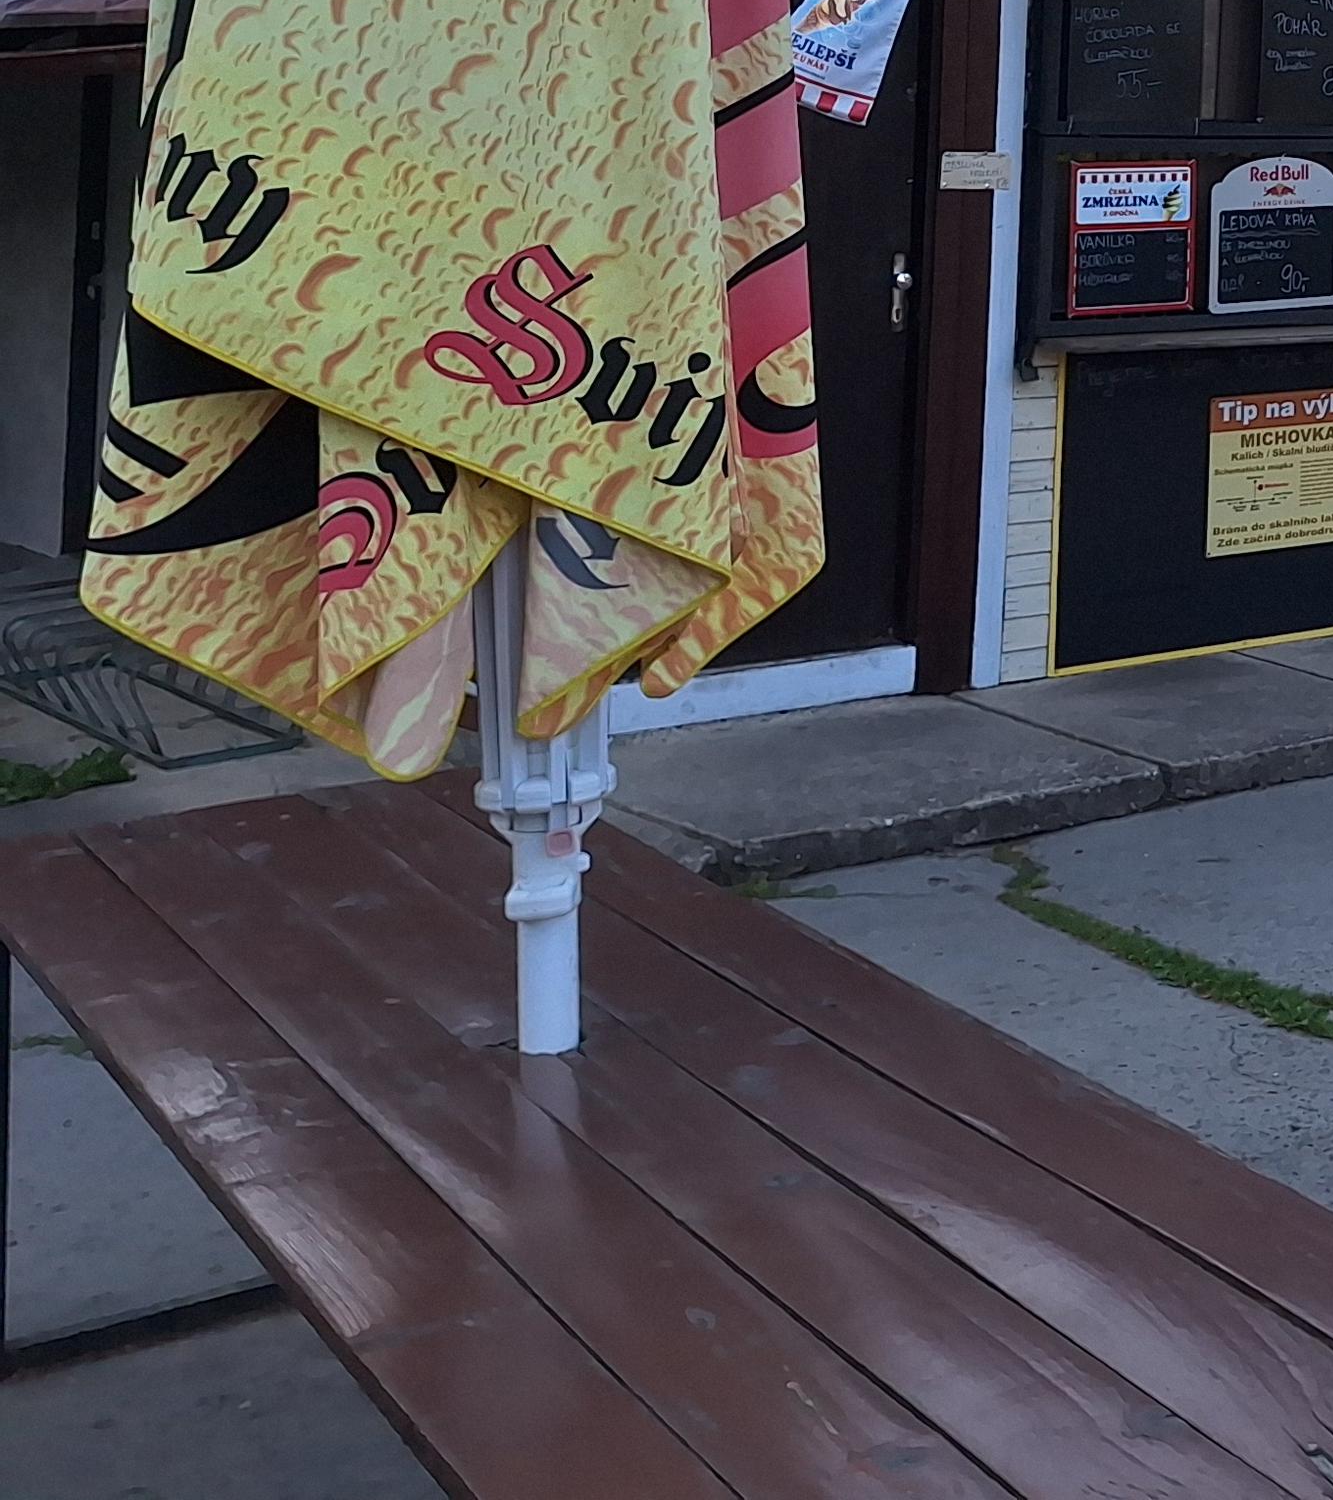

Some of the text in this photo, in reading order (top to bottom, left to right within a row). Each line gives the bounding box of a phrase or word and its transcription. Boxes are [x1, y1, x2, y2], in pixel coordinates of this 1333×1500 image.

[1082, 195, 1159, 208] ZMRZLINA
[1079, 234, 1135, 251] VANILKA
[1218, 400, 1258, 425] Tip
[1265, 398, 1296, 419] na
[1231, 450, 1264, 462] Kalich
[1212, 523, 1249, 537] Brána
[1252, 520, 1267, 532] do
[1269, 515, 1319, 531] skalního
[1217, 536, 1241, 548] Zde
[1243, 529, 1282, 545] začíná
